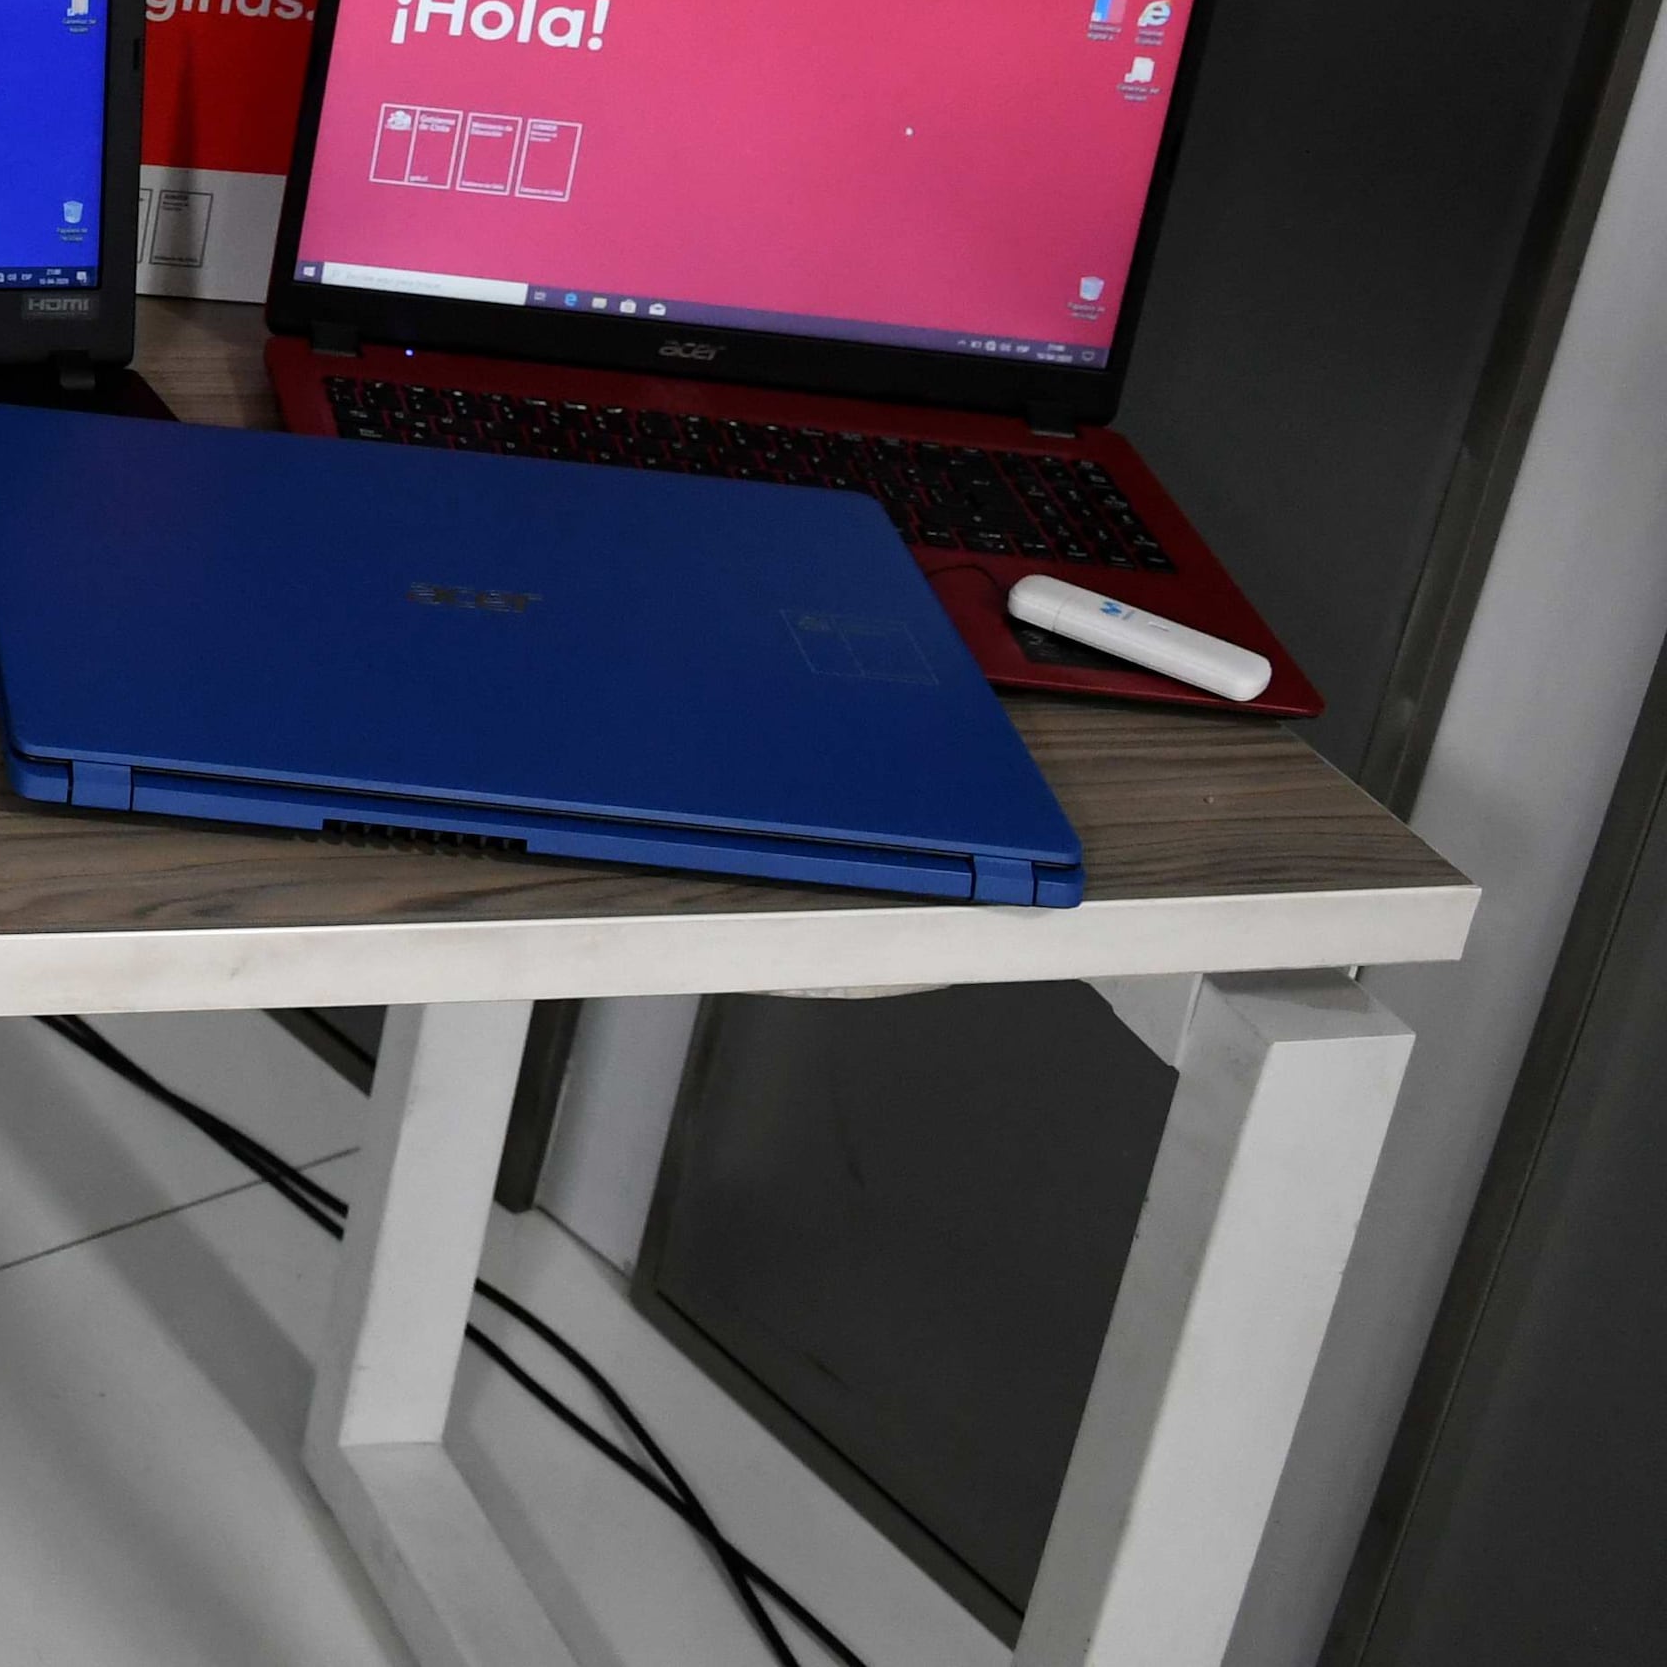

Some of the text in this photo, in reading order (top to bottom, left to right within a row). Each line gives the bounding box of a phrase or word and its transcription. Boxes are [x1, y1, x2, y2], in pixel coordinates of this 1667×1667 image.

[28, 298, 89, 310] HDMI
[658, 340, 727, 361] acer
[405, 582, 543, 614] acer
